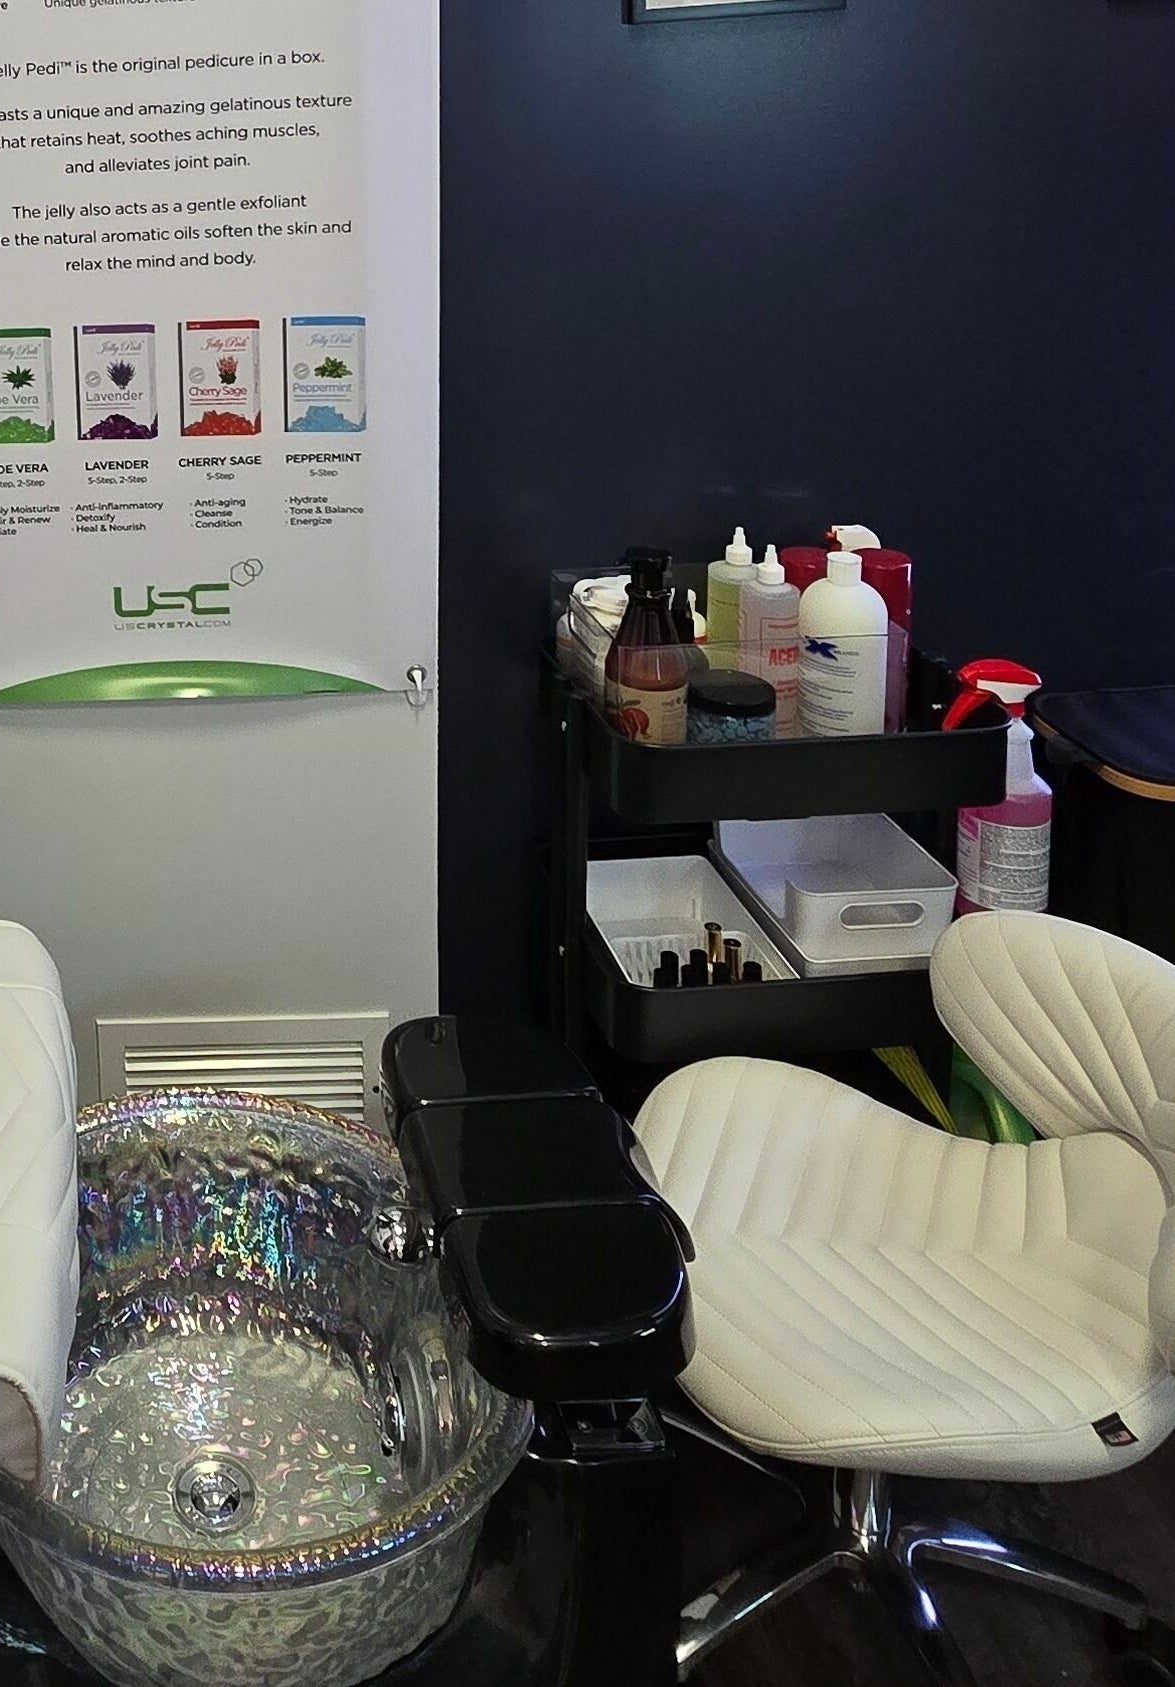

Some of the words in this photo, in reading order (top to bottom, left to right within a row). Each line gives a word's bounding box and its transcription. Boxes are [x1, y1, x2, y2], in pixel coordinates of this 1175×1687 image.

[76, 60, 88, 74] is
[92, 59, 118, 73] the
[121, 56, 181, 73] original
[186, 54, 254, 71] pedicure
[259, 52, 272, 66] in
[276, 54, 287, 65] a
[292, 50, 325, 64] box.
[33, 110, 43, 120] a
[47, 105, 100, 121] unique
[104, 102, 135, 117] and
[138, 100, 205, 116] amazing
[210, 97, 291, 114] gelatinous
[296, 94, 353, 108] texture
[31, 133, 83, 147] retains
[87, 132, 125, 147] heat,
[130, 128, 191, 144] soothes
[196, 125, 248, 142] aching
[253, 123, 320, 138] muscles,
[65, 160, 95, 174] and
[99, 157, 170, 172] alleviates
[174, 155, 209, 172] joint
[214, 153, 251, 170] pain.
[12, 206, 41, 219] The
[44, 204, 75, 220] jelly
[80, 205, 111, 217] also
[115, 204, 147, 216] acts
[151, 205, 169, 214] as
[172, 202, 183, 213] a
[187, 197, 236, 214] gentle
[240, 195, 307, 210] exfoliant
[15, 233, 41, 246] the
[44, 230, 96, 245] natural
[100, 228, 170, 242] aromatic
[174, 226, 200, 240] oils
[204, 223, 254, 238] soften
[258, 223, 283, 236] the
[287, 221, 318, 235] skin
[322, 219, 352, 233] and
[66, 257, 102, 272] relax
[106, 256, 132, 270] the
[136, 253, 175, 268] mind
[180, 252, 209, 266] and
[214, 251, 256, 267] body.
[188, 386, 220, 398] Cherry
[223, 386, 248, 398] Sage
[292, 382, 353, 394] Peppermint
[12, 394, 40, 405] Vera
[85, 391, 144, 403] Lavender
[177, 456, 228, 468] CHERRY
[228, 454, 263, 466] SAGE
[286, 452, 363, 464] PEPPERMINT
[15, 462, 49, 474] VERA
[85, 459, 150, 472] LAVENDER
[205, 472, 234, 481] 5-Step
[310, 469, 339, 477] 5-Step
[17, 478, 46, 488] 2-Step
[87, 477, 117, 486] 5-Step,
[119, 475, 149, 484] 2-Step
[75, 502, 165, 513] Anti-inflammatory
[194, 497, 247, 509] Anti-aging
[290, 496, 329, 507] Hydrate
[11, 504, 61, 514] Moisturize
[194, 510, 234, 519] Cleanse
[289, 505, 314, 515] Tone
[315, 505, 323, 515] &
[325, 504, 365, 514] Balance
[9, 516, 16, 525] &
[18, 515, 52, 525] Renew
[76, 512, 116, 523] Detoxify
[290, 516, 333, 527] Energize
[76, 523, 99, 534] Heal
[100, 523, 108, 533] &
[109, 522, 147, 532] Nourish
[195, 519, 243, 529] Condition
[113, 583, 230, 617] USC
